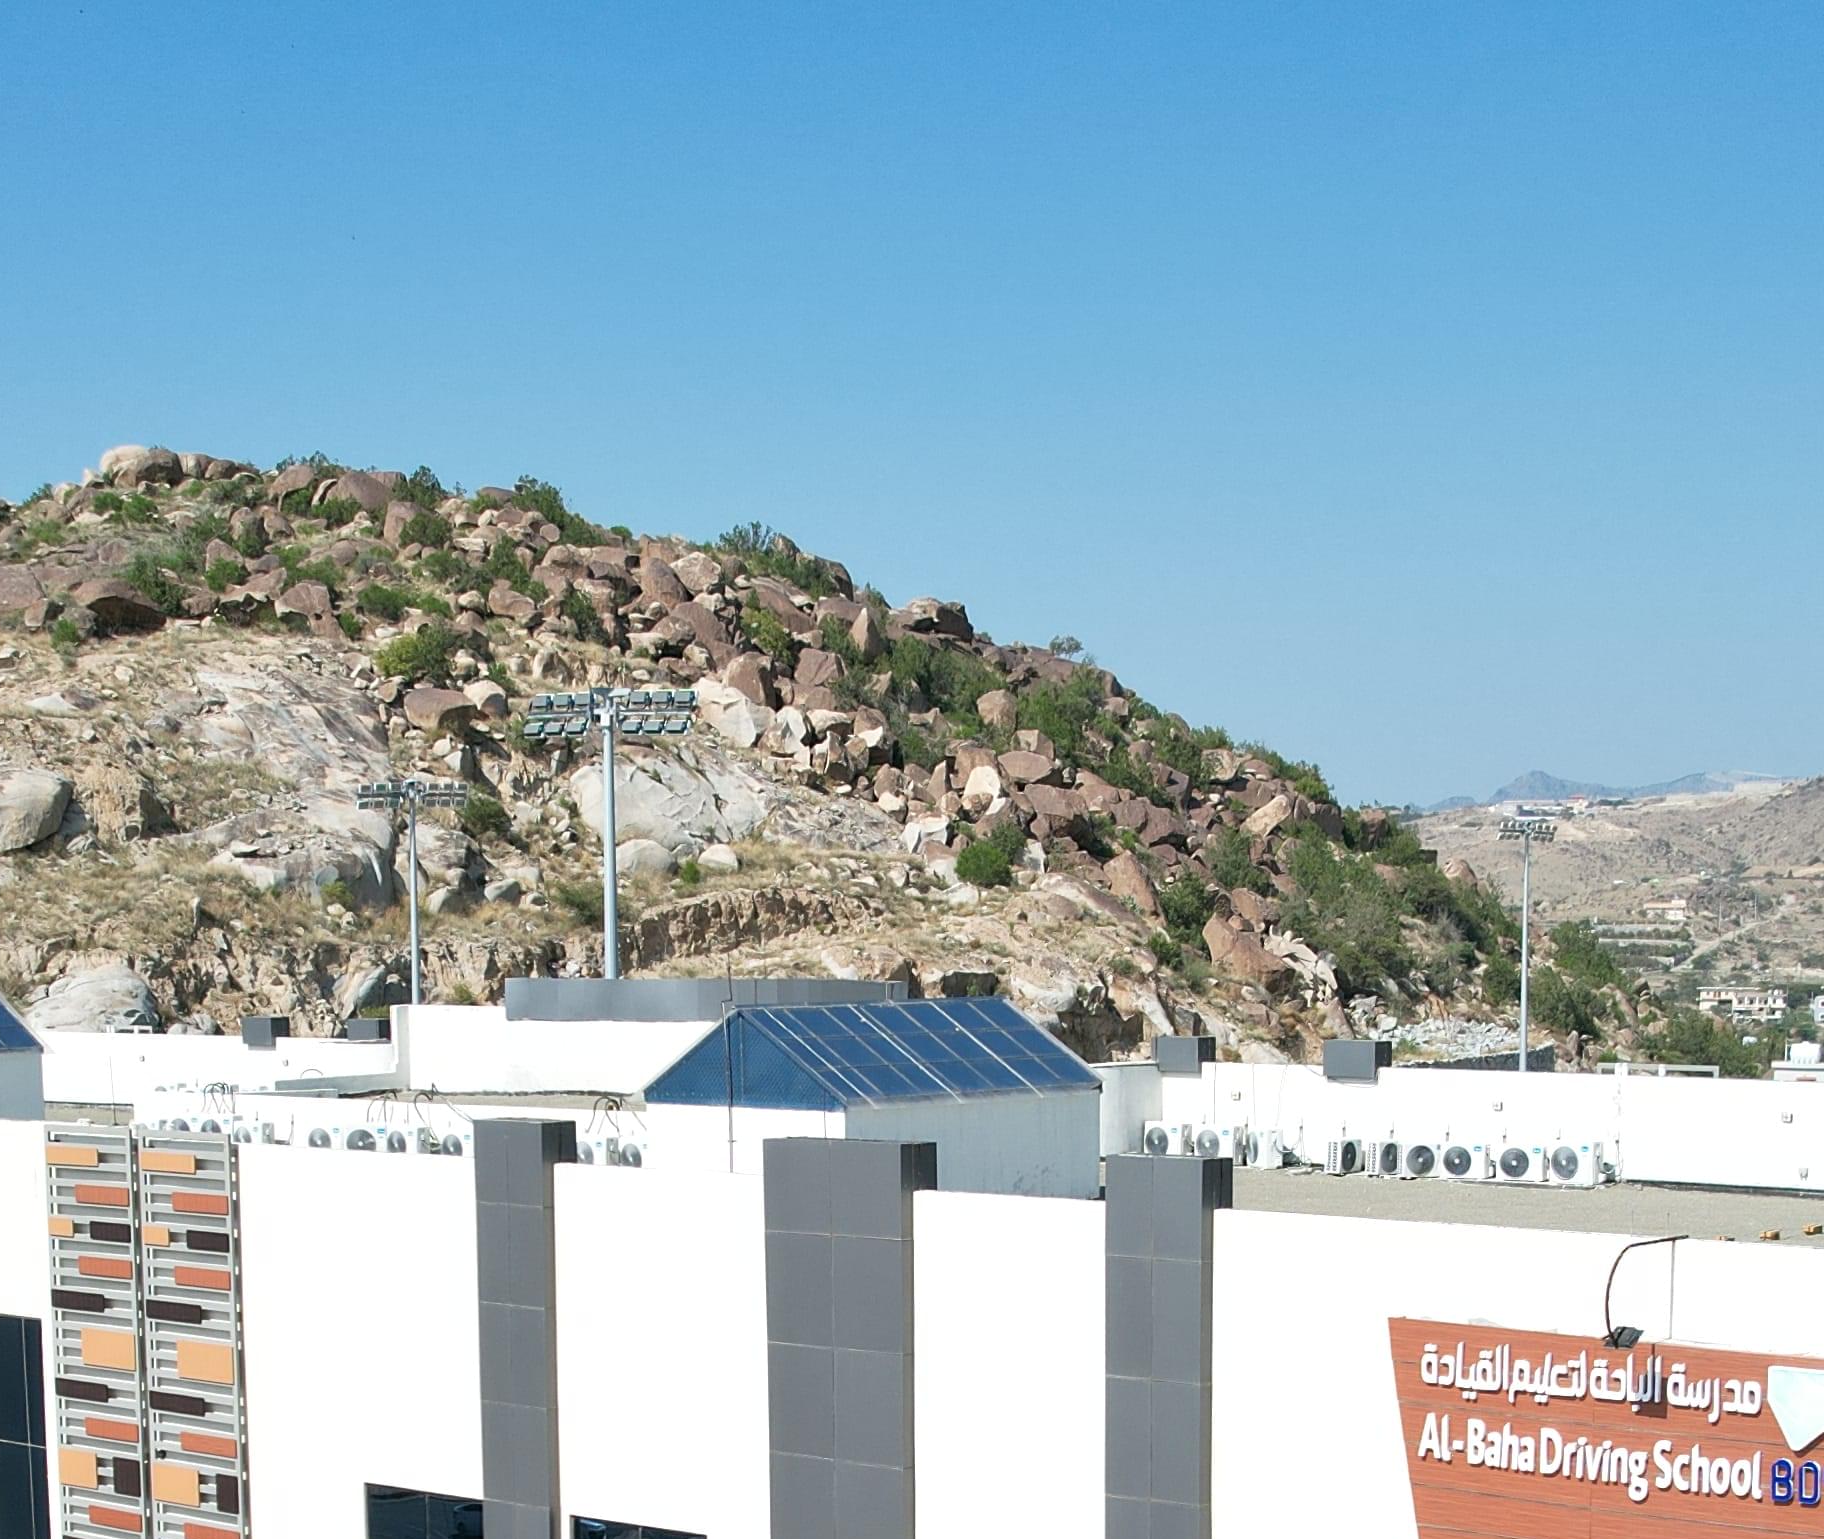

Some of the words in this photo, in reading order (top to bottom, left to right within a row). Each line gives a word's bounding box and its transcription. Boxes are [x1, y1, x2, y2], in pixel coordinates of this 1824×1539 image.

[1420, 1341, 1511, 1401] القيادة
[1508, 1349, 1588, 1404] لتعليم
[1589, 1352, 1663, 1413] الباحة
[1666, 1362, 1763, 1424] مدرسة
[1417, 1411, 1536, 1473] Al-Baha
[1539, 1426, 1649, 1502] Driving
[1653, 1439, 1763, 1500] School
